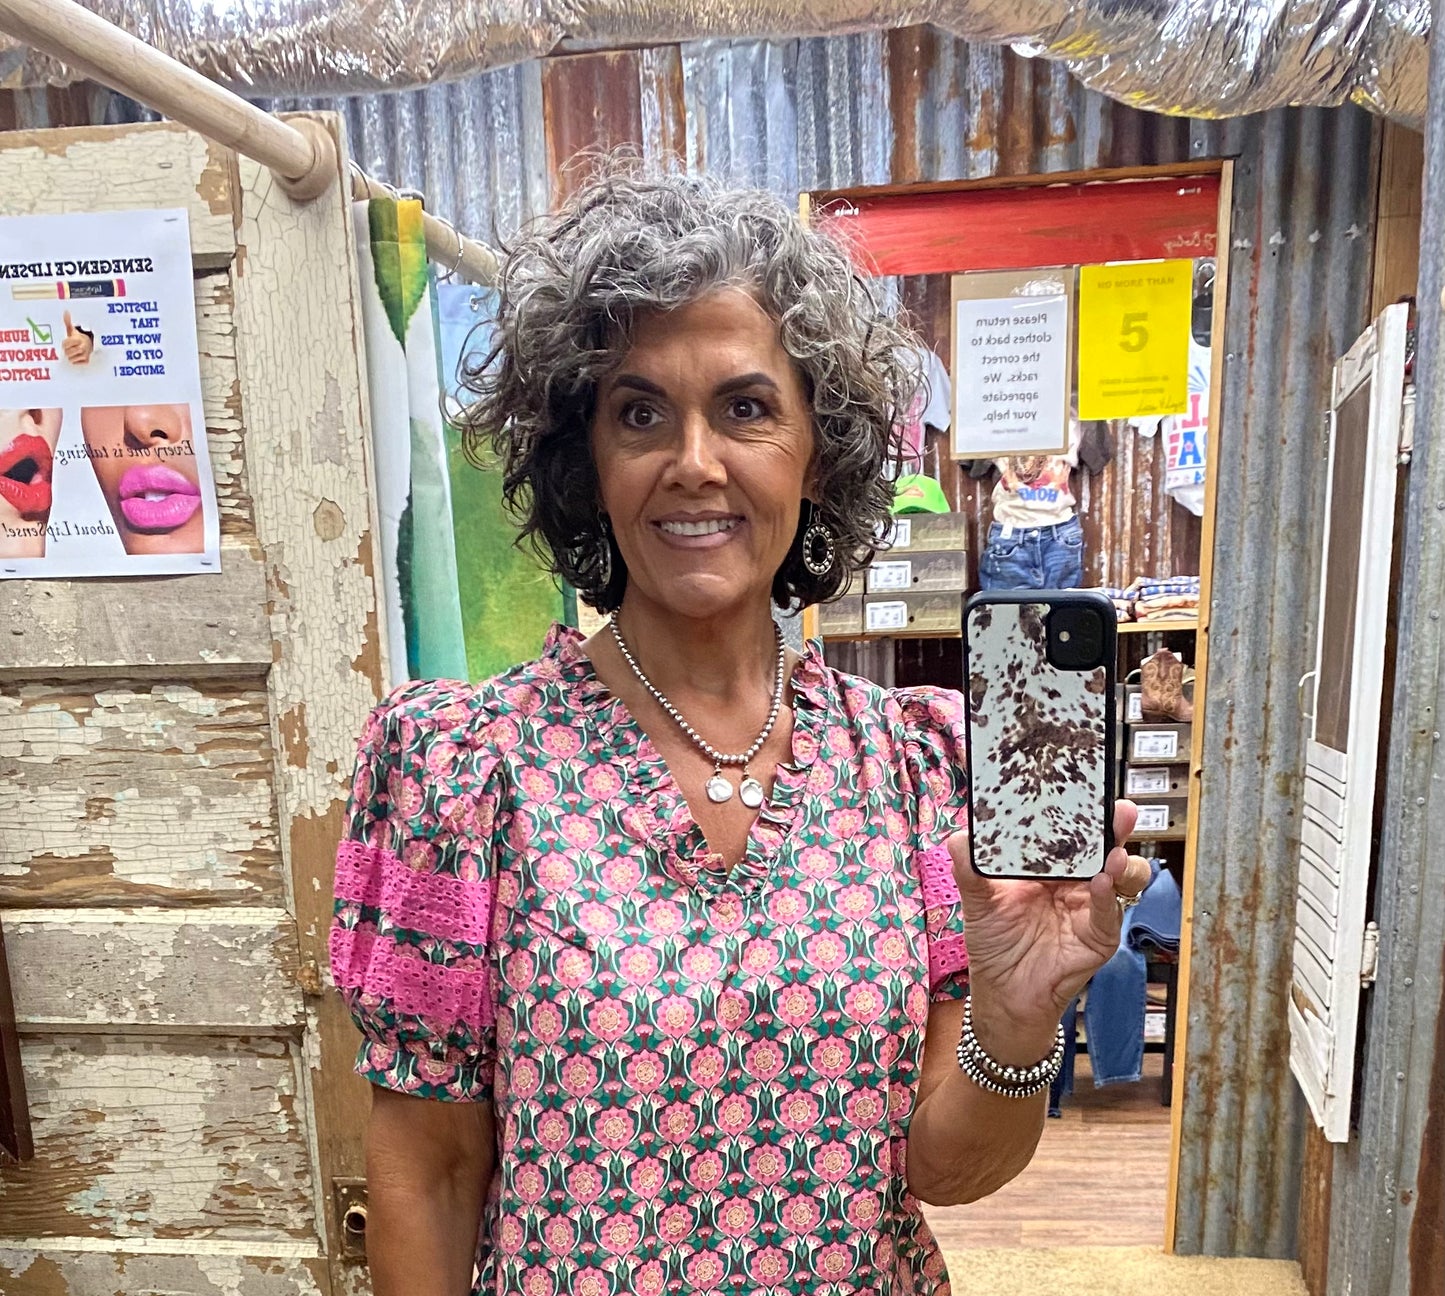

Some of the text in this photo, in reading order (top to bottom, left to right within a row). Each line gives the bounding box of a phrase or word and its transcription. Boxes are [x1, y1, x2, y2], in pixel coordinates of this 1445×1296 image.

[1114, 278, 1144, 288] MORE
[1146, 277, 1175, 286] THAN
[1118, 312, 1149, 353] 5
